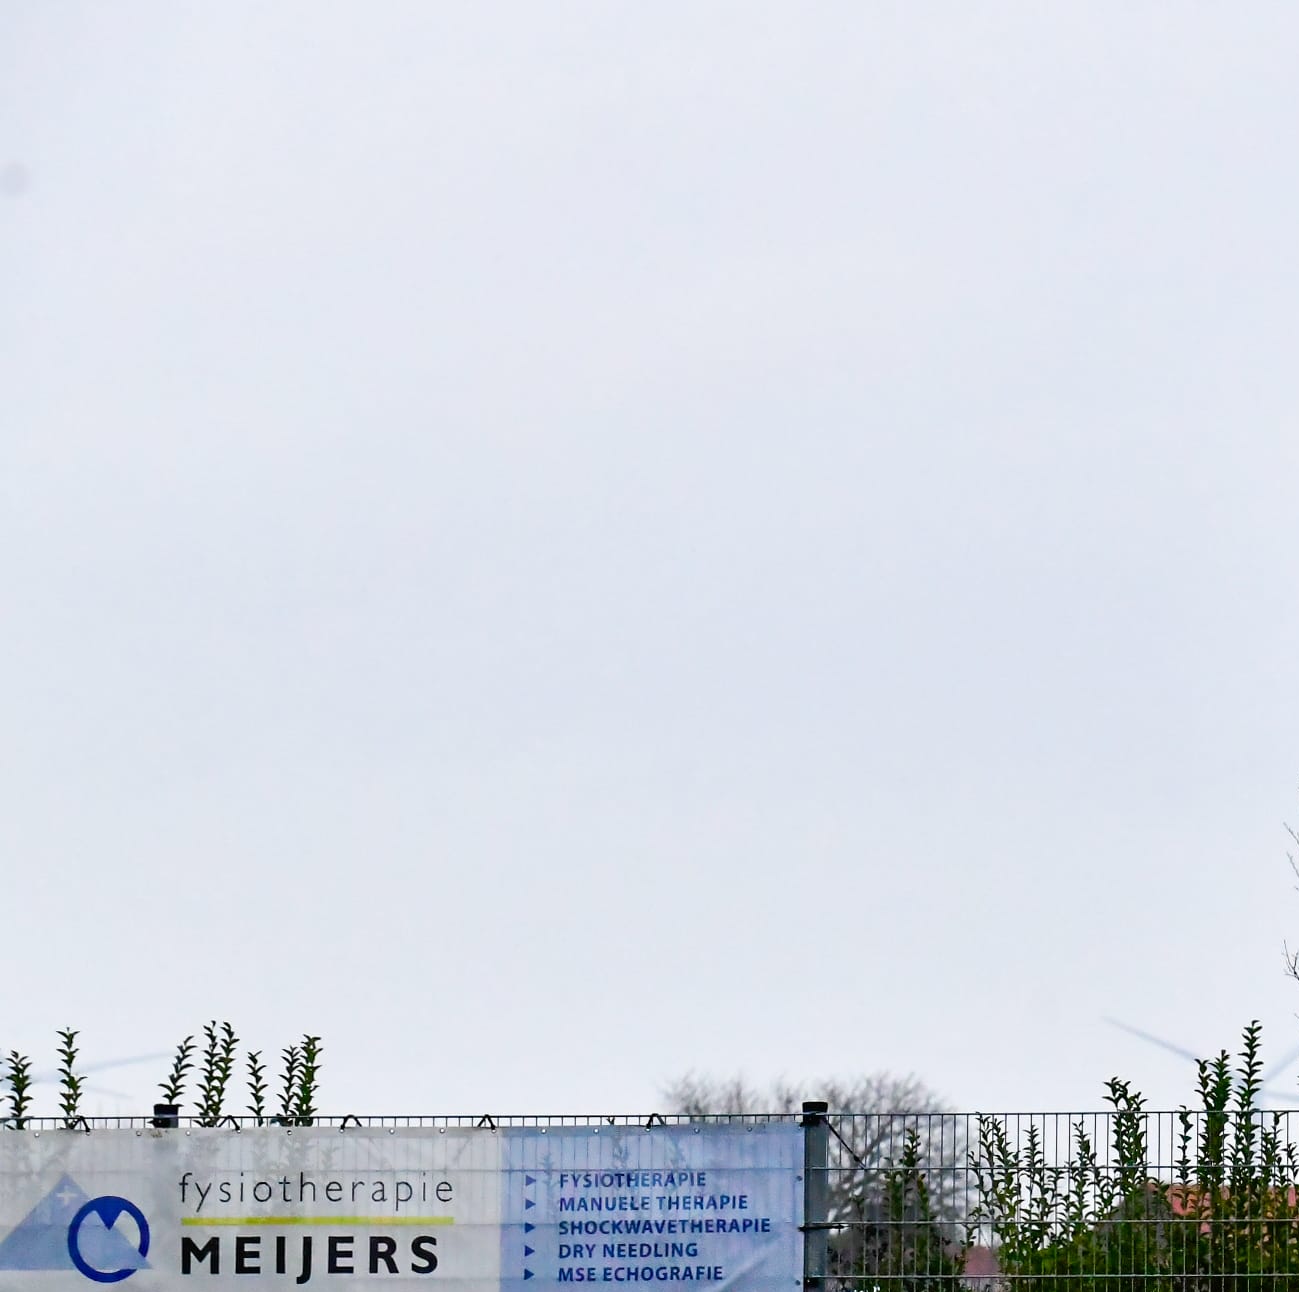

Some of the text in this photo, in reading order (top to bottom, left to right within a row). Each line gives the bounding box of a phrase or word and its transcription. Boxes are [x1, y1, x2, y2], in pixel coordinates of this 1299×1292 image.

[558, 1171, 707, 1189] FYSIOTHERAPIE
[179, 1172, 454, 1212] fysiotherapie
[559, 1194, 748, 1212] MANUELE THERAPIE
[558, 1217, 771, 1236] SHOCKWAVETHERAPIE
[182, 1236, 438, 1284] MEIJERS
[558, 1241, 699, 1260] DRY NEEDLING
[558, 1265, 724, 1283] MSE ECHOGRAFIE
